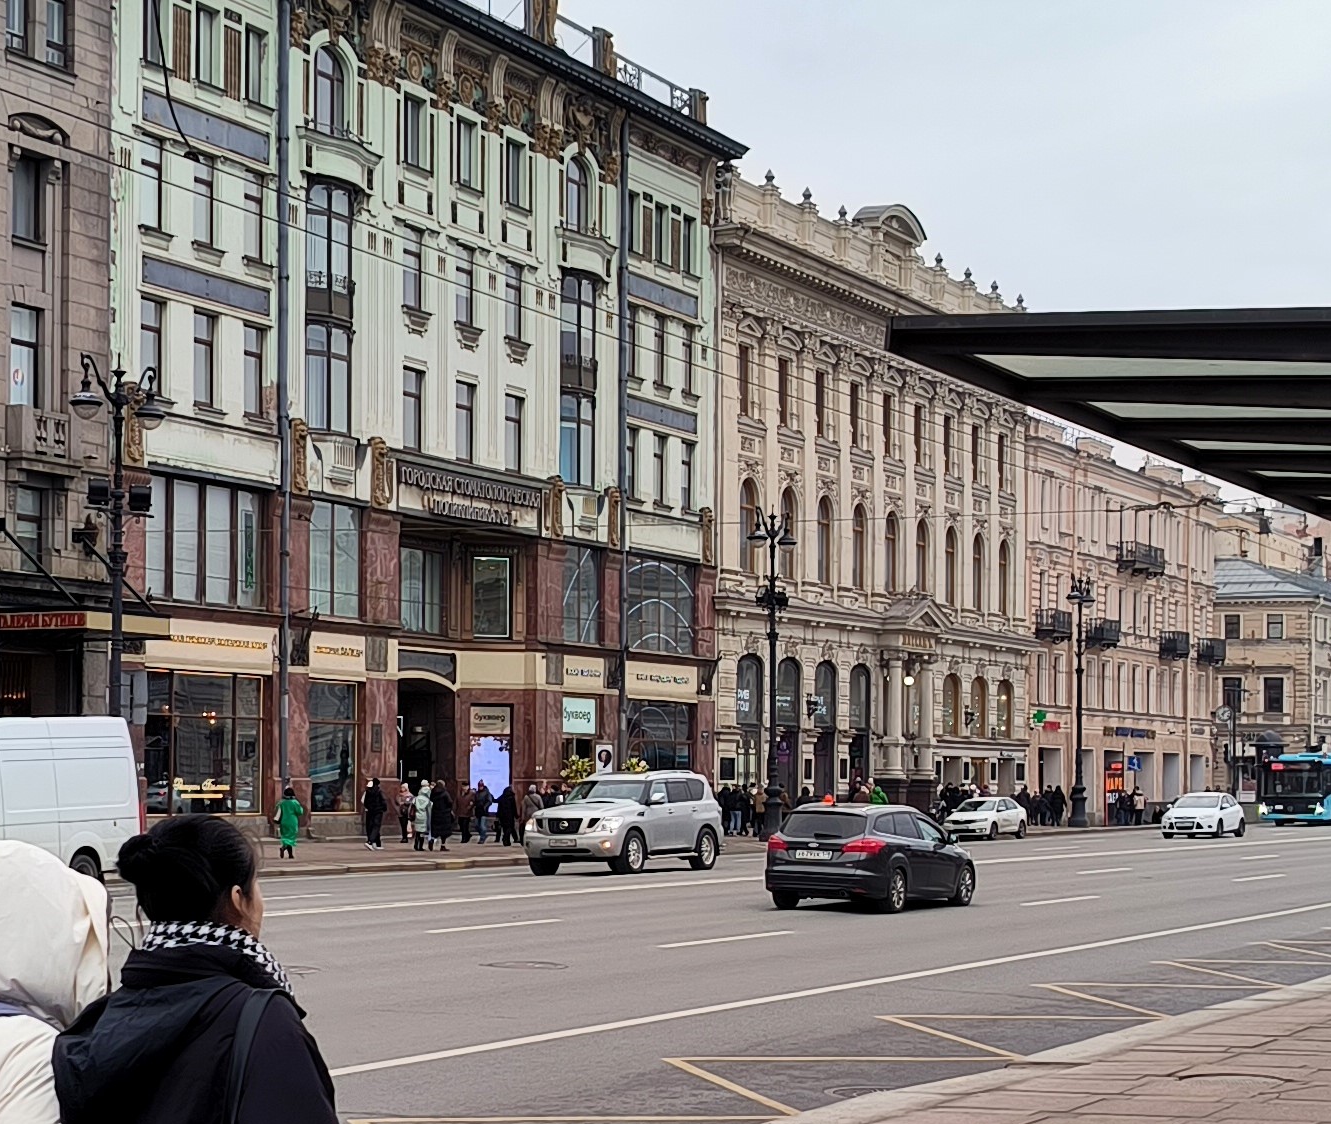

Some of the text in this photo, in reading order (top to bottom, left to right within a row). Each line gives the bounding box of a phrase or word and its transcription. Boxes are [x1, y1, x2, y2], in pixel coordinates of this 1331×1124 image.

[401, 466, 540, 508] ГОРОДСКАЯ СТОМАТОЛОГИЧЕСКАЯ
[433, 498, 495, 523] ПОЛИКЛИНИКА
